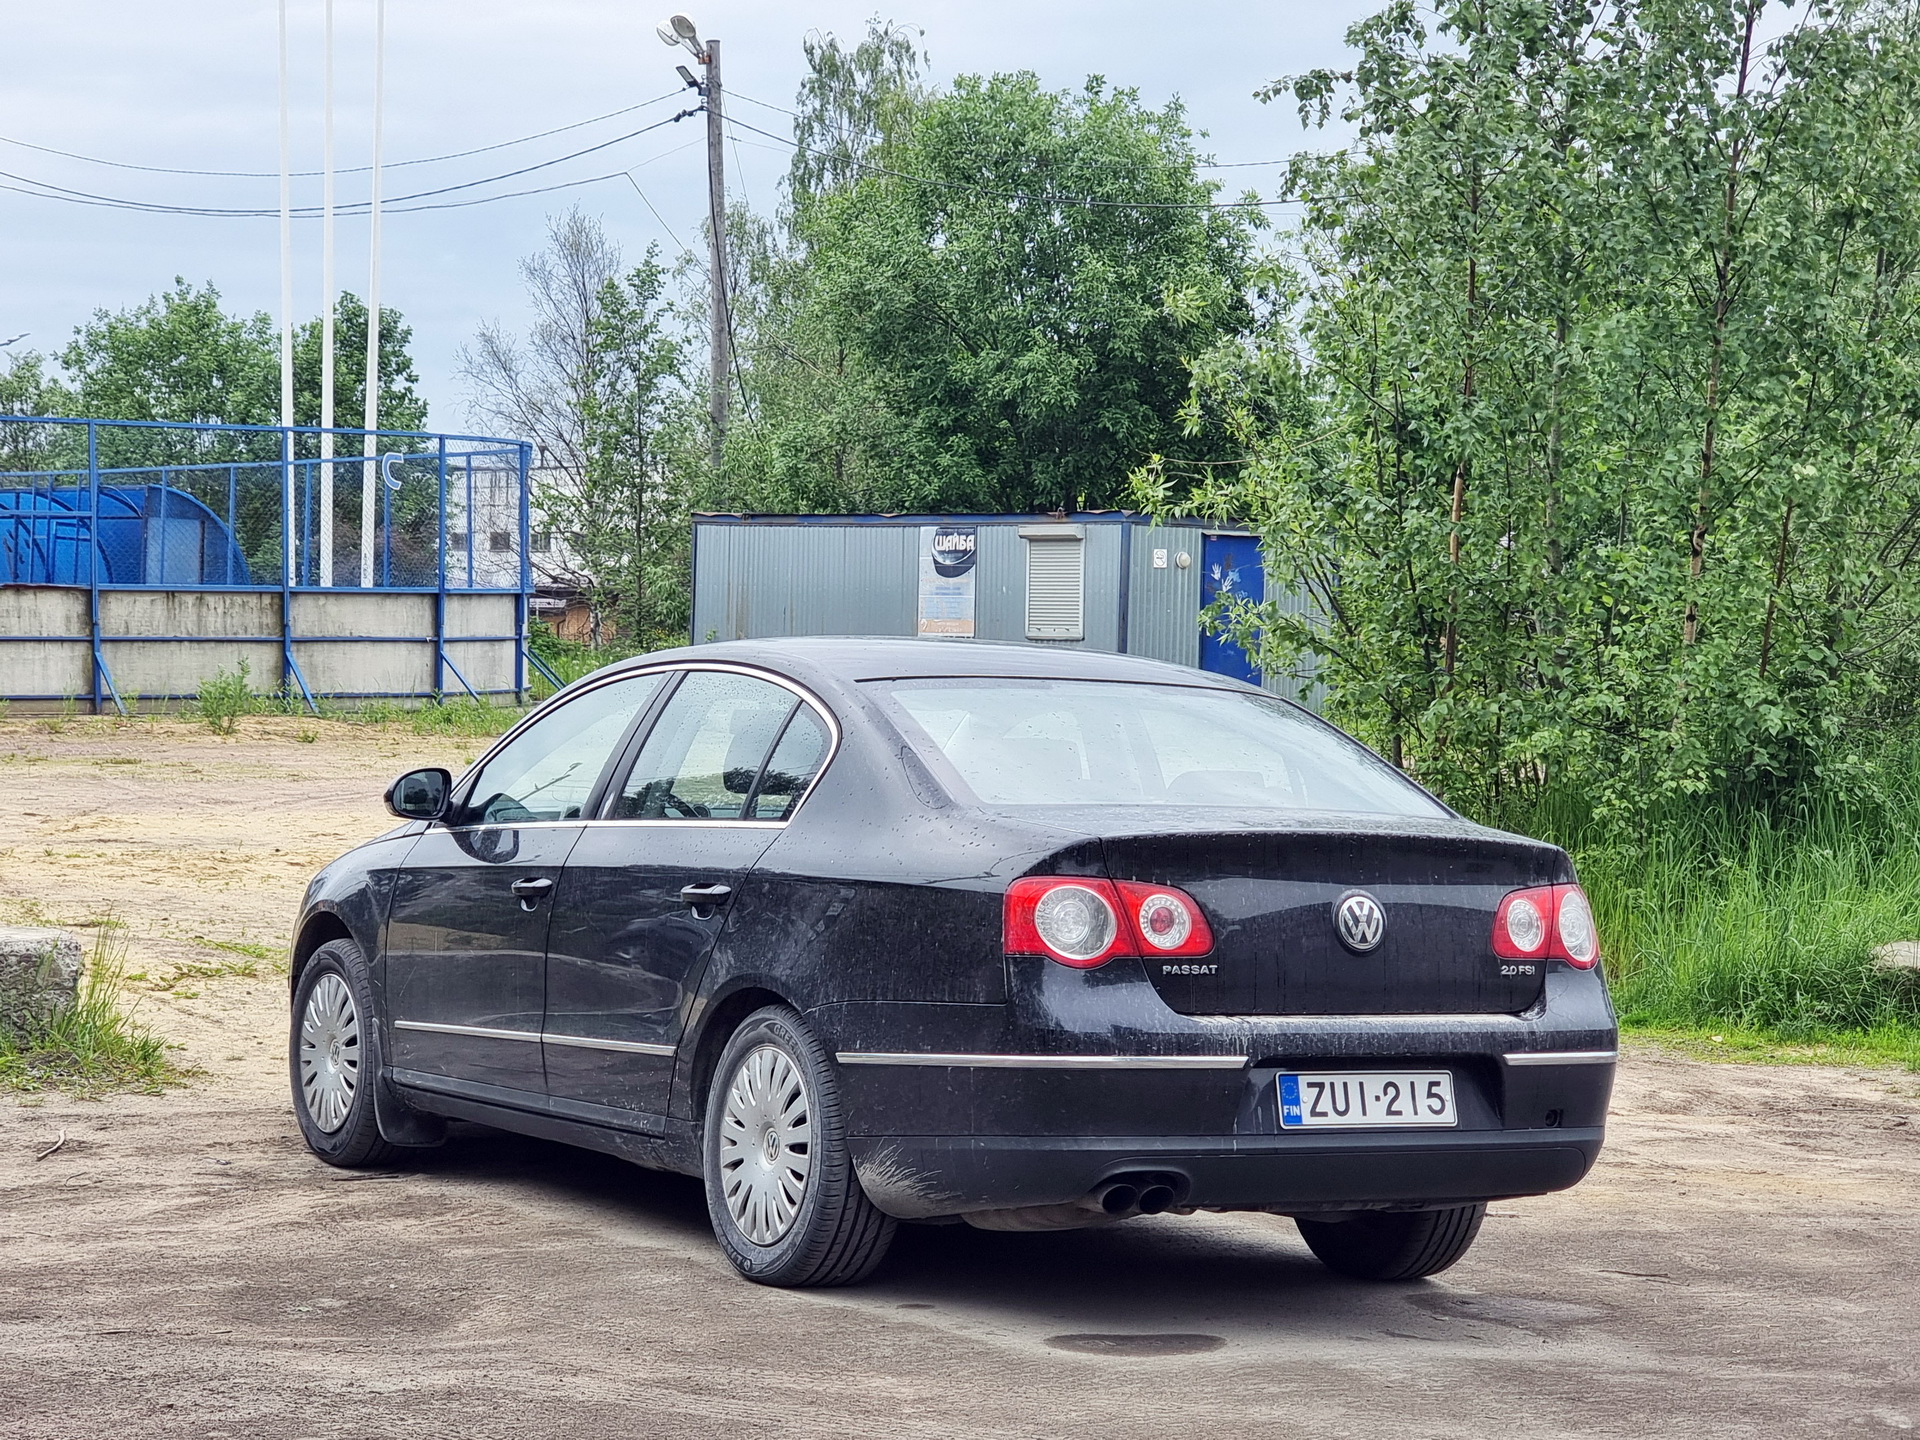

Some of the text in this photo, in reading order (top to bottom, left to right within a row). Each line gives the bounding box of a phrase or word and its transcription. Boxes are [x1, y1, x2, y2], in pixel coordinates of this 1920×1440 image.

[935, 532, 975, 552] ШАЙБА
[1162, 964, 1218, 975] PASSAT
[1518, 965, 1535, 975] FSI
[1283, 1105, 1301, 1117] FIN
